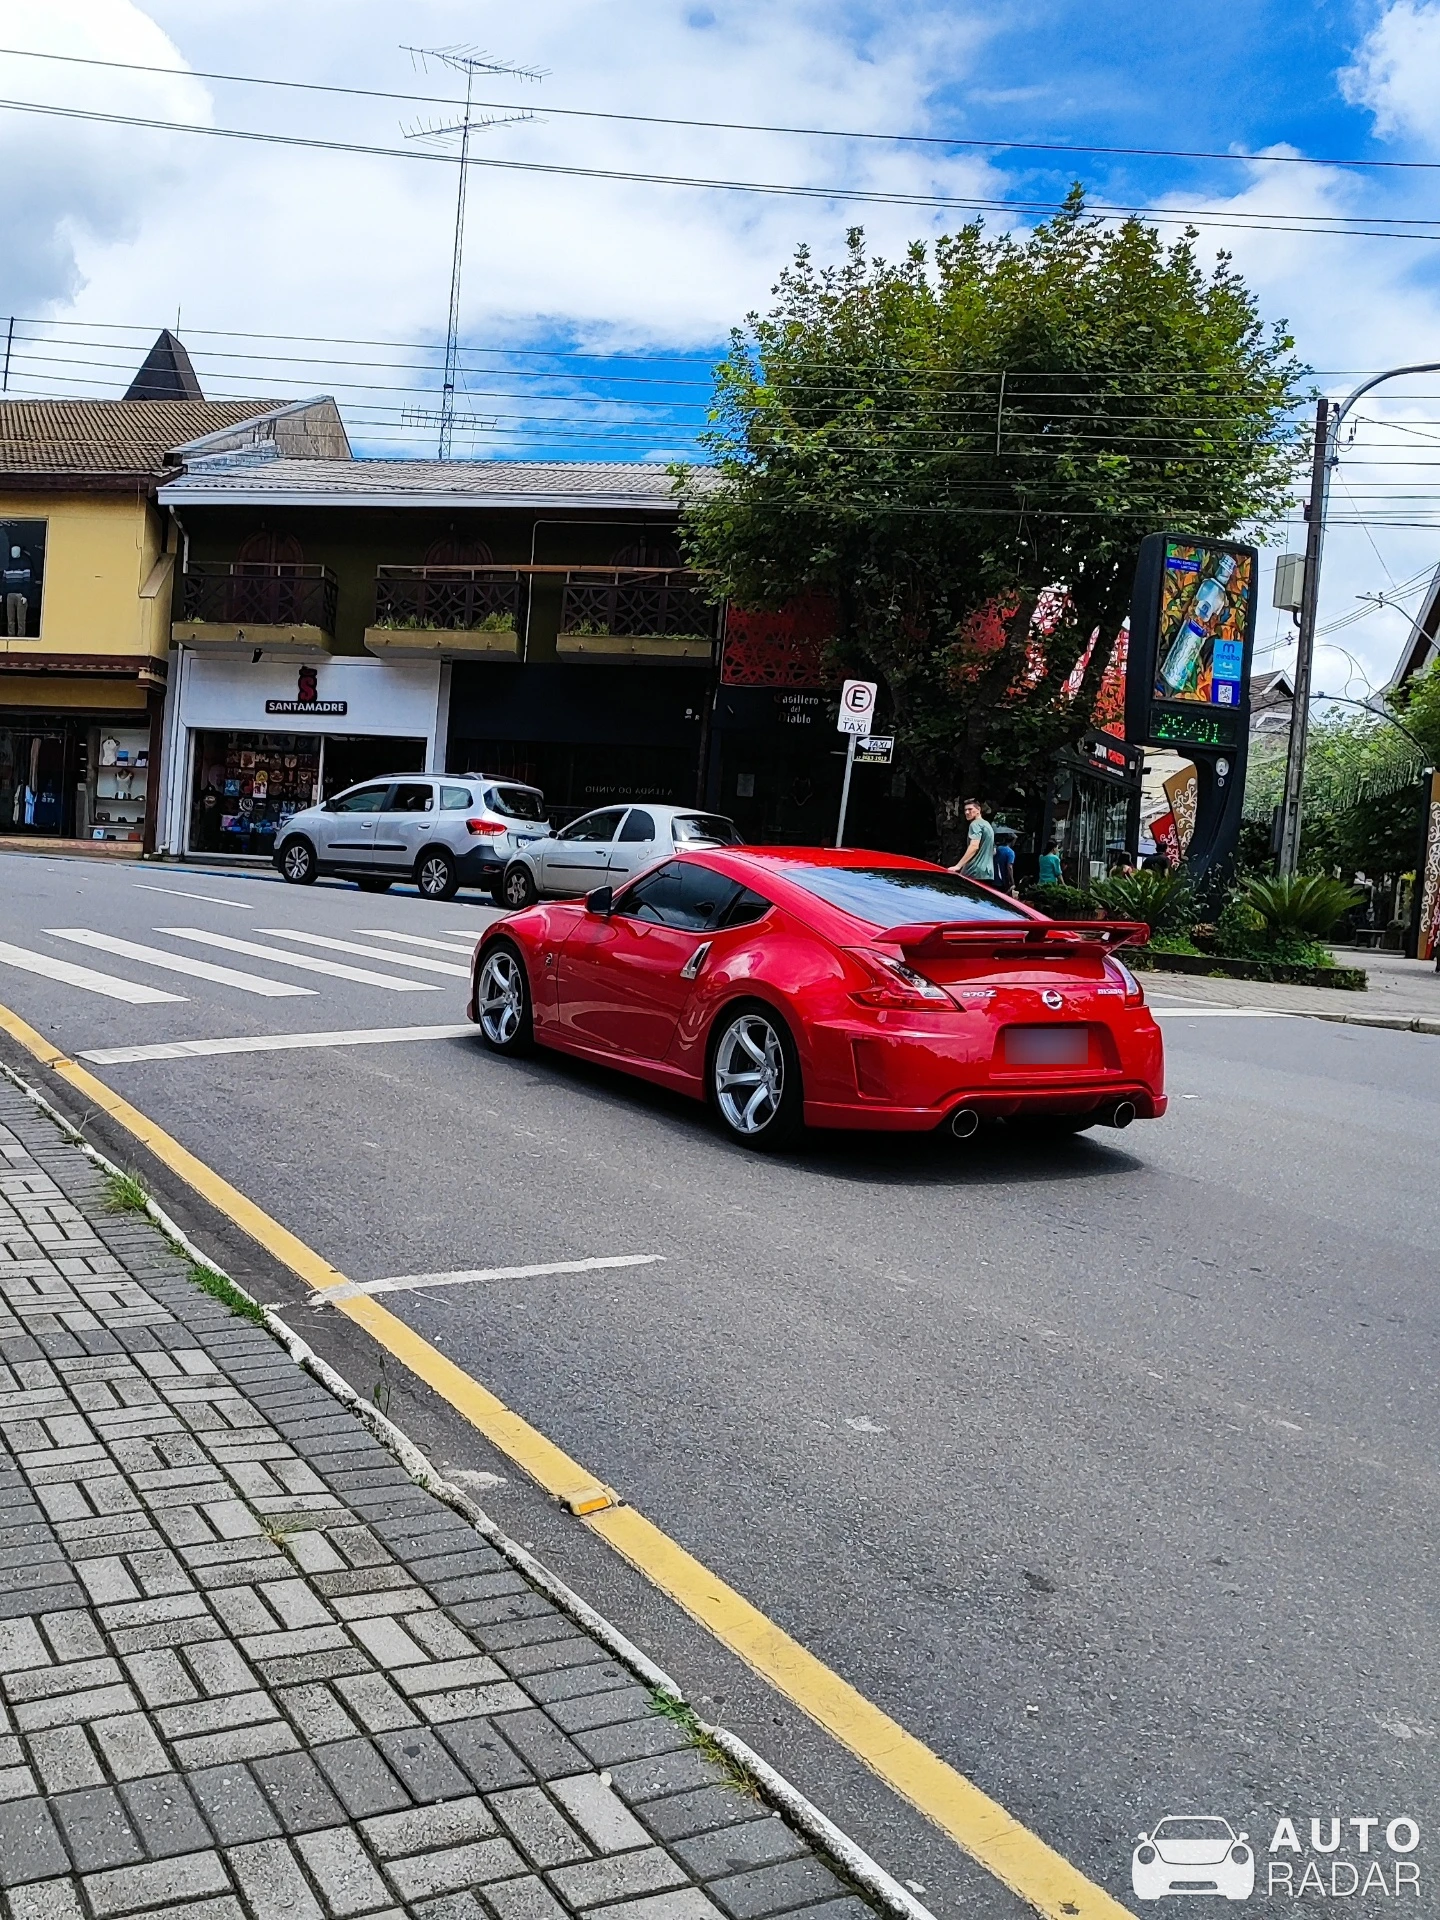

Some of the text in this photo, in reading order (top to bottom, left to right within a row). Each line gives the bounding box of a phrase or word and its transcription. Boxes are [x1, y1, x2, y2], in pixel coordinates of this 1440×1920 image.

[851, 689, 866, 708] E
[269, 702, 345, 712] SANTAMADRE
[790, 705, 801, 713] del
[843, 721, 867, 733] TAXI
[868, 740, 888, 749] TAXI
